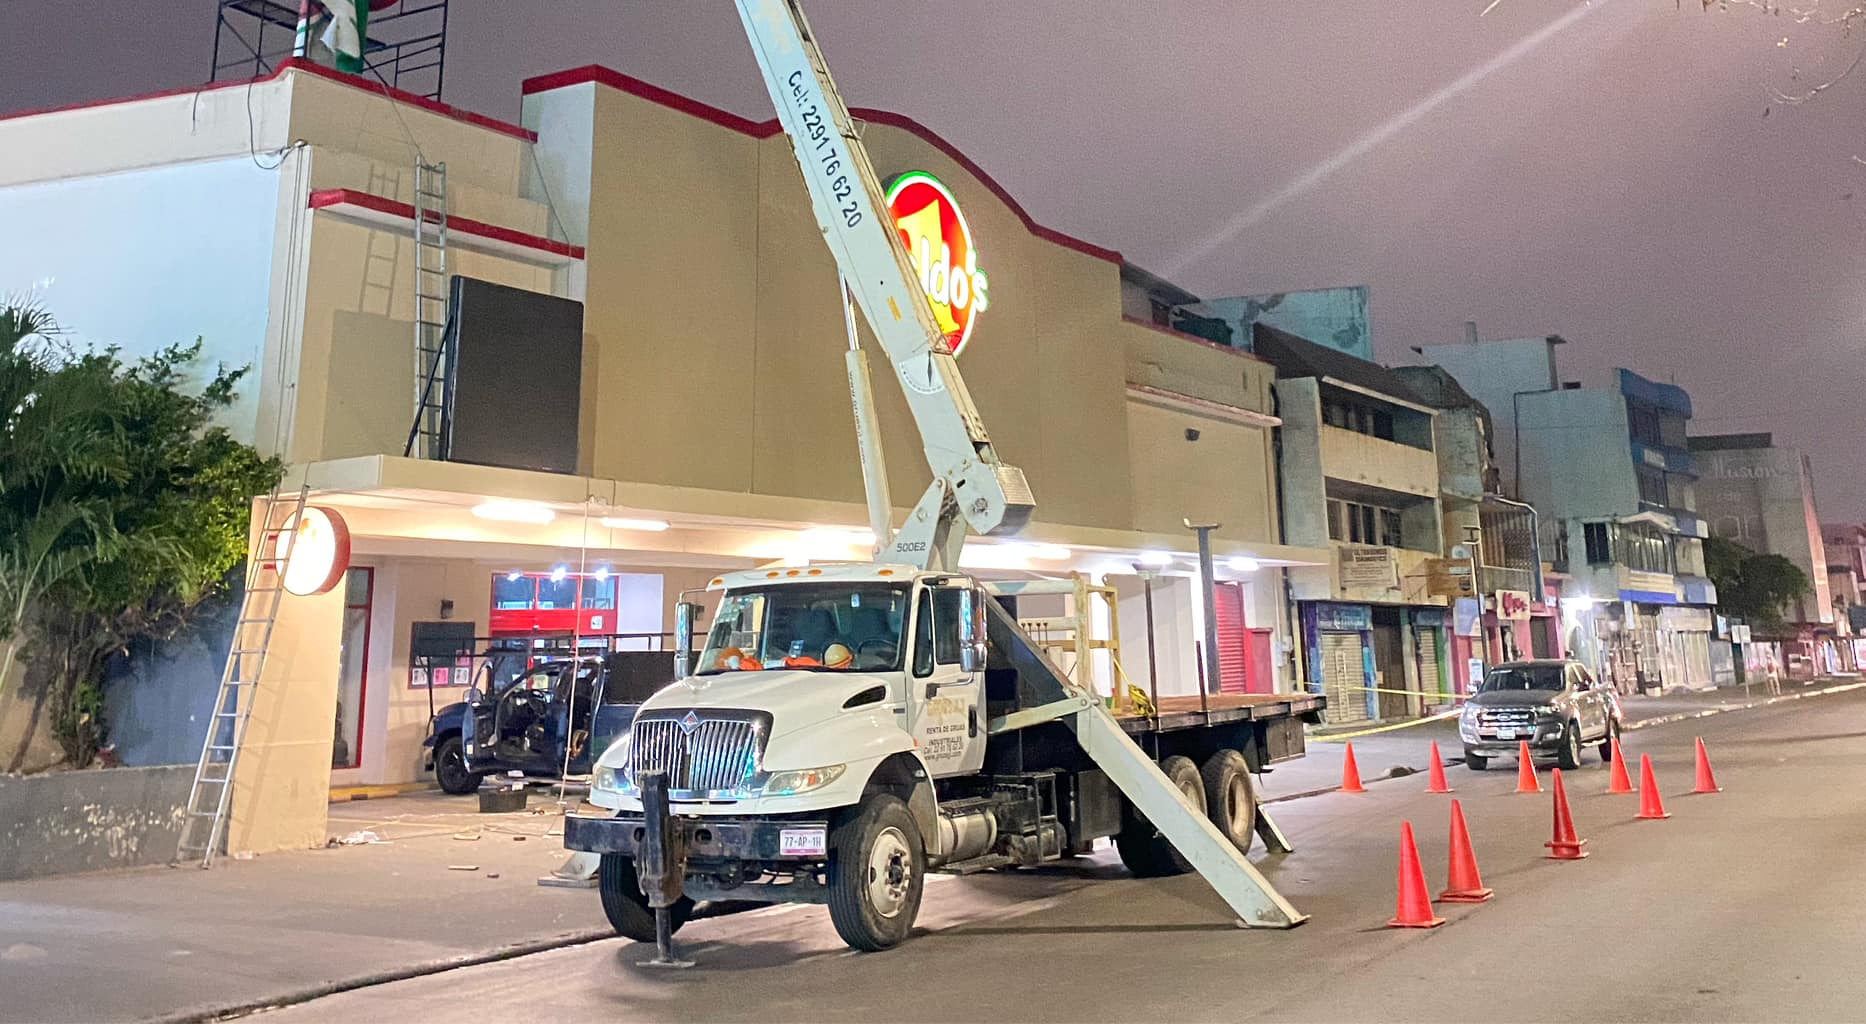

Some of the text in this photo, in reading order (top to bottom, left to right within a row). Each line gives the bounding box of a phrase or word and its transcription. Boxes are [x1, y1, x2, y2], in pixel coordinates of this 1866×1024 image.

[802, 105, 831, 150] 2291
[821, 147, 841, 176] 76
[832, 175, 852, 202] 62
[842, 202, 863, 228] 20
[909, 235, 989, 313] ldo's
[896, 542, 926, 553] 500E2
